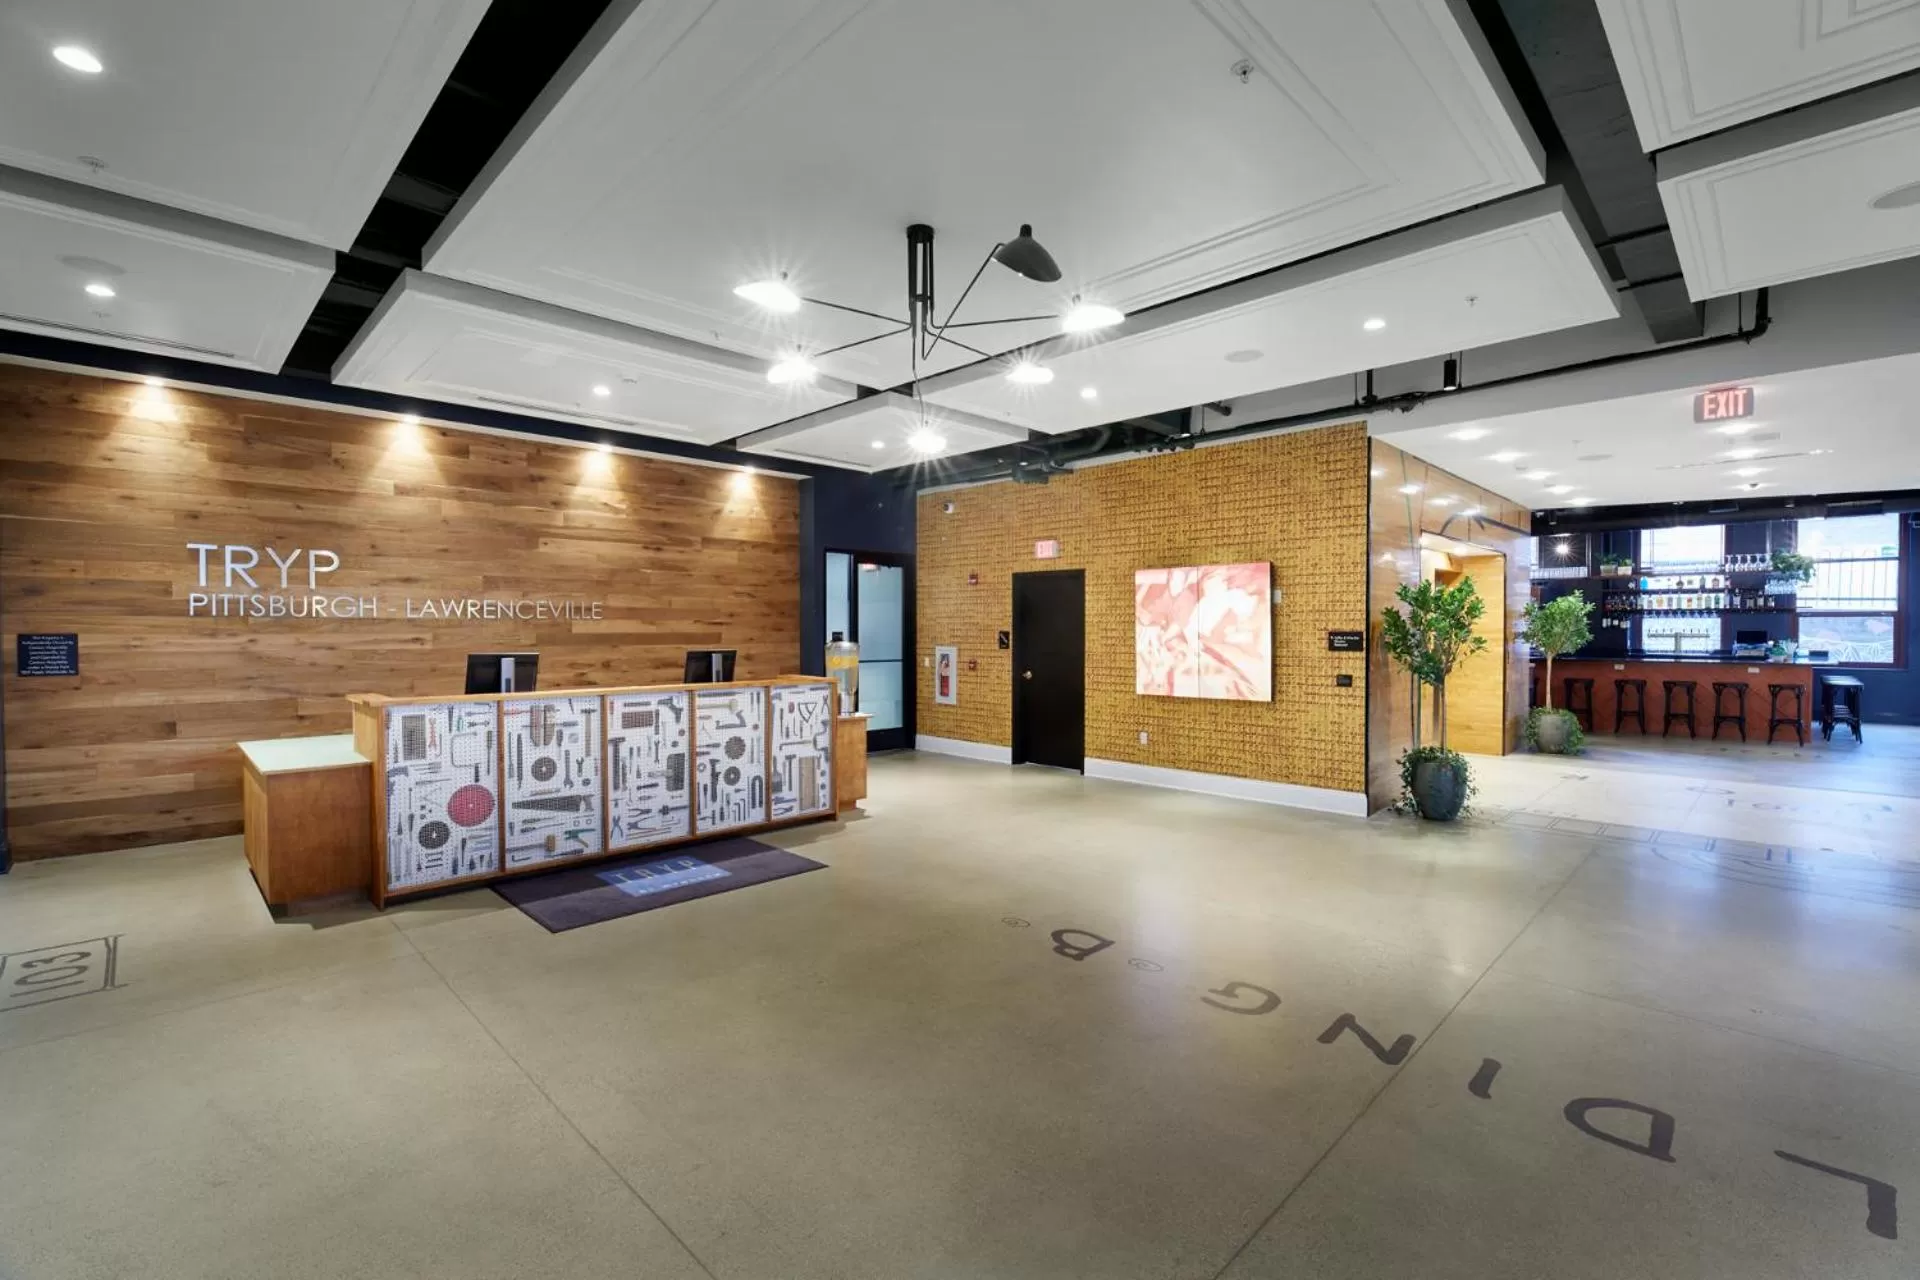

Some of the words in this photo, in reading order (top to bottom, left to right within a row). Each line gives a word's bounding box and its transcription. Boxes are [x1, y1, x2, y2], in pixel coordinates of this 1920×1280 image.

[1703, 388, 1748, 421] EXIT
[186, 543, 340, 590] TRYP
[189, 593, 377, 618] PITTSBURGH
[406, 598, 604, 620] LAWRENCEVILLE
[611, 859, 697, 883] TRYP
